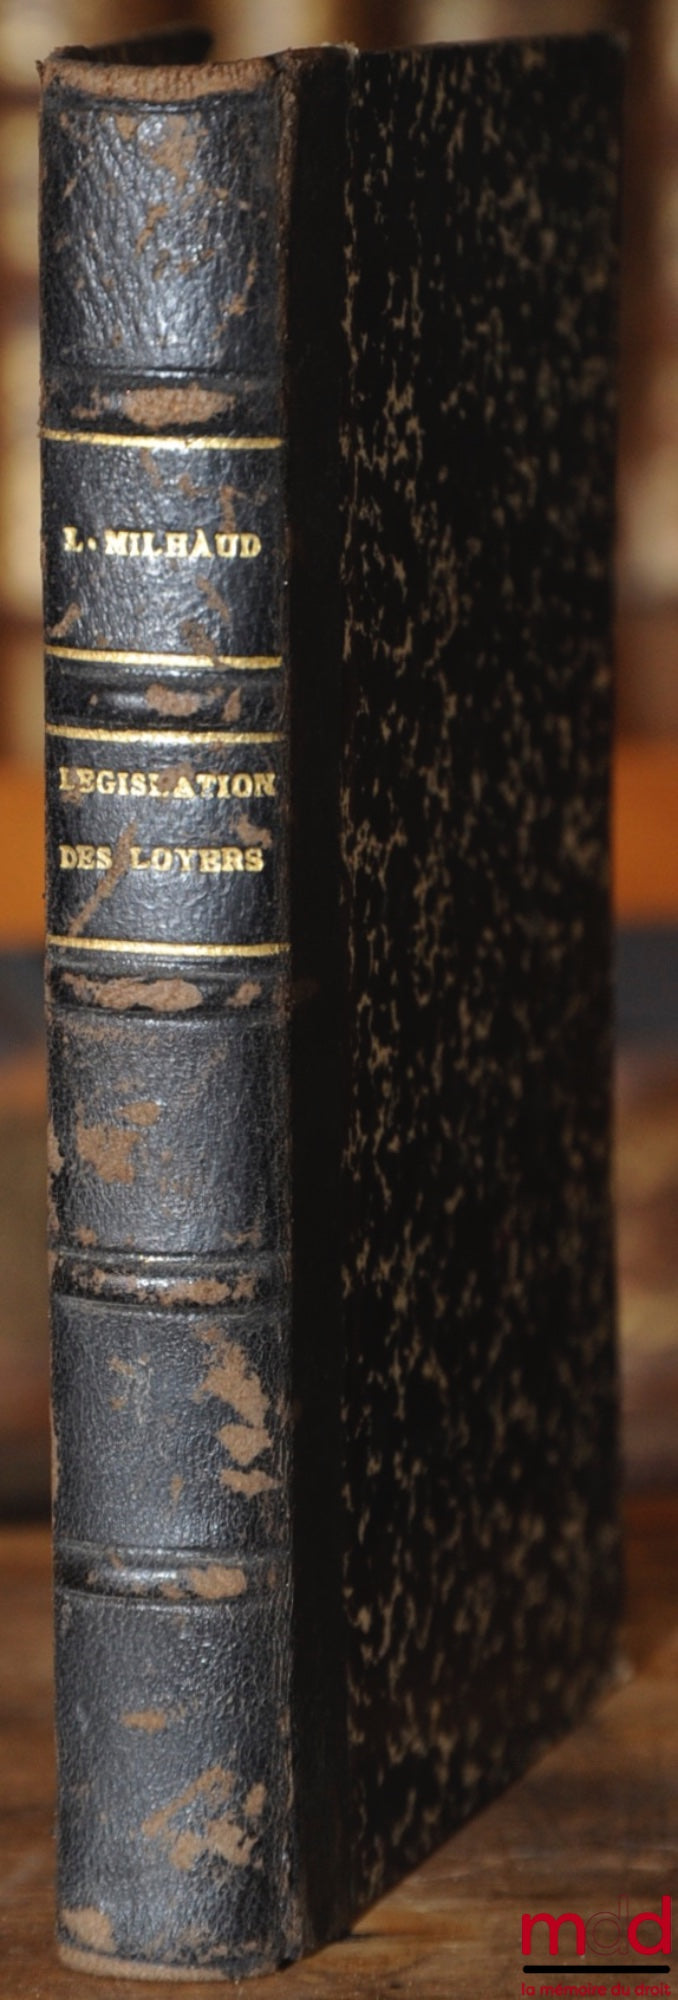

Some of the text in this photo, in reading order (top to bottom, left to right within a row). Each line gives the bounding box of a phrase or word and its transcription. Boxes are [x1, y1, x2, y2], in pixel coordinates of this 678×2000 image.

[104, 528, 262, 558] MILHAUD
[59, 766, 276, 798] LEGISLATION
[59, 844, 265, 873] DES LOYERS
